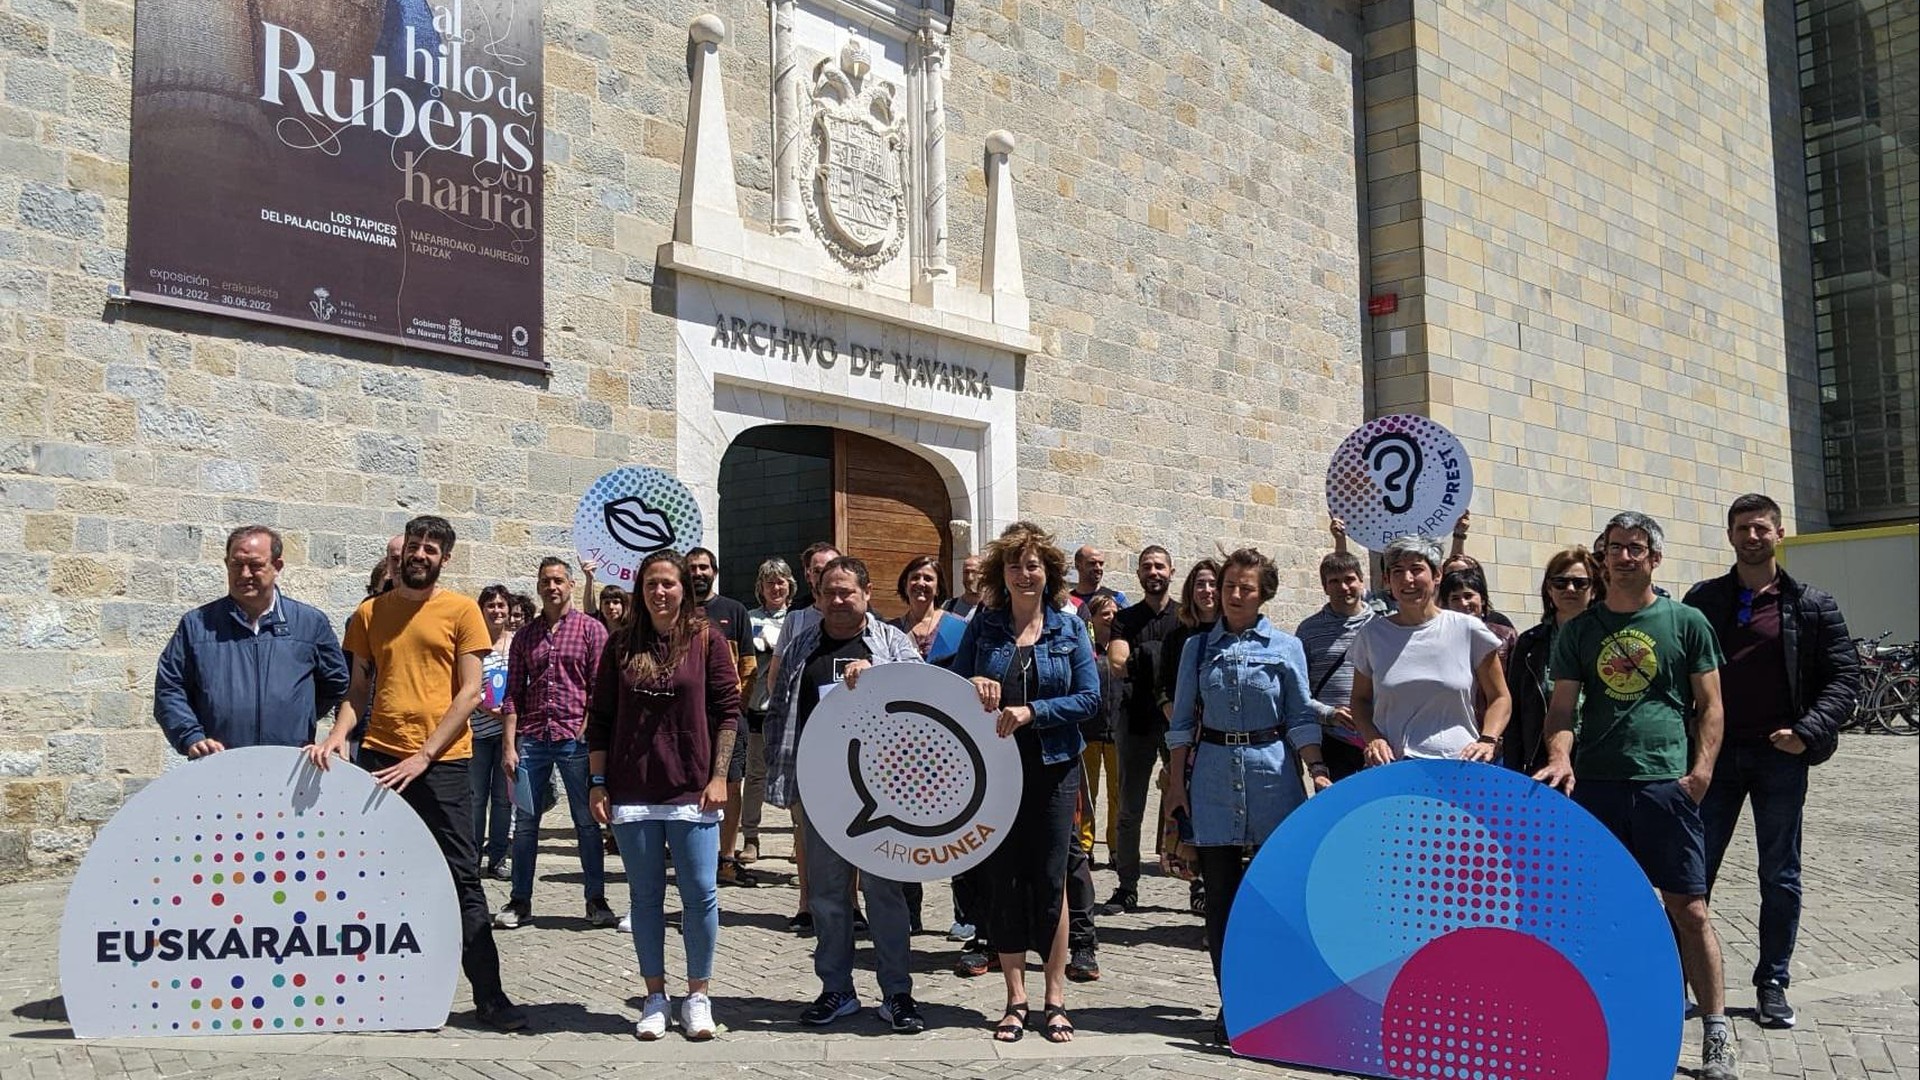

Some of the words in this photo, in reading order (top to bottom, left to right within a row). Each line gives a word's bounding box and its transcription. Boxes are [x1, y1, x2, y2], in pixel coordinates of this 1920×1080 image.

[432, 0, 463, 38] al
[404, 26, 494, 101] hilo
[498, 77, 534, 115] de
[260, 21, 534, 172] Rubens
[404, 151, 534, 229] harira
[502, 169, 533, 195] en
[261, 209, 283, 223] DEL
[284, 214, 331, 234] PALACIO
[332, 227, 347, 237] DE
[348, 230, 397, 248] NAVARRA
[330, 211, 352, 226] LOS
[355, 217, 397, 235] TAPICES
[410, 230, 476, 253] NAFARROAKO
[477, 246, 530, 265] JAUREGIKO
[410, 242, 451, 260] TAPIZAK
[149, 268, 210, 287] exposición
[221, 281, 279, 300] erakusketa
[156, 283, 209, 301] 11.04.2022
[221, 294, 272, 312] 30.06.2022
[406, 327, 417, 335] de
[417, 328, 446, 341] Navarra
[412, 317, 446, 331] Gobierno
[464, 336, 499, 350] Gobernua
[711, 313, 837, 369] ARCHIVO
[850, 343, 883, 379] DE
[892, 351, 993, 400] NAVARRA
[874, 823, 996, 865] ARIGUNEA
[96, 921, 422, 963] EUSKARALDIA
